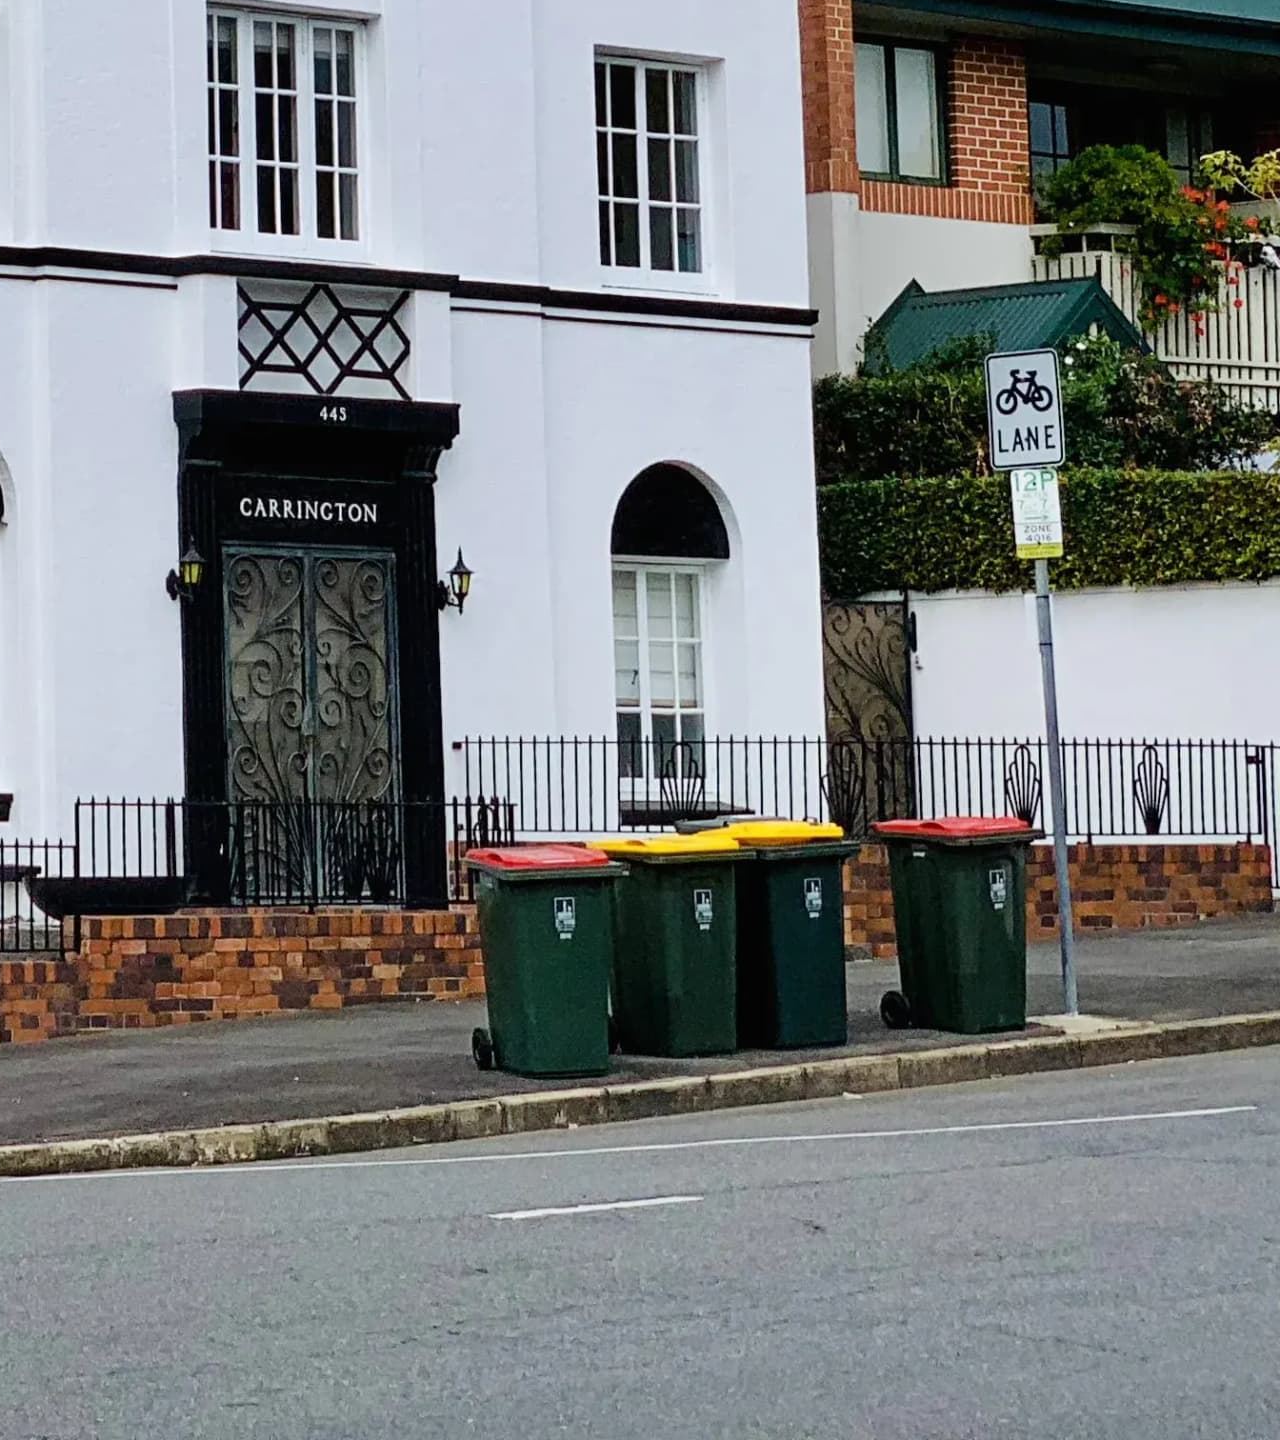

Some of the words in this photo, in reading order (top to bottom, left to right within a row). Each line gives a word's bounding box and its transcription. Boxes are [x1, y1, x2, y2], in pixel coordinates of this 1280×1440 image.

[319, 406, 347, 421] 445
[998, 425, 1056, 453] LANE
[1014, 470, 1055, 492] 12P
[240, 497, 377, 523] CARRINGTON
